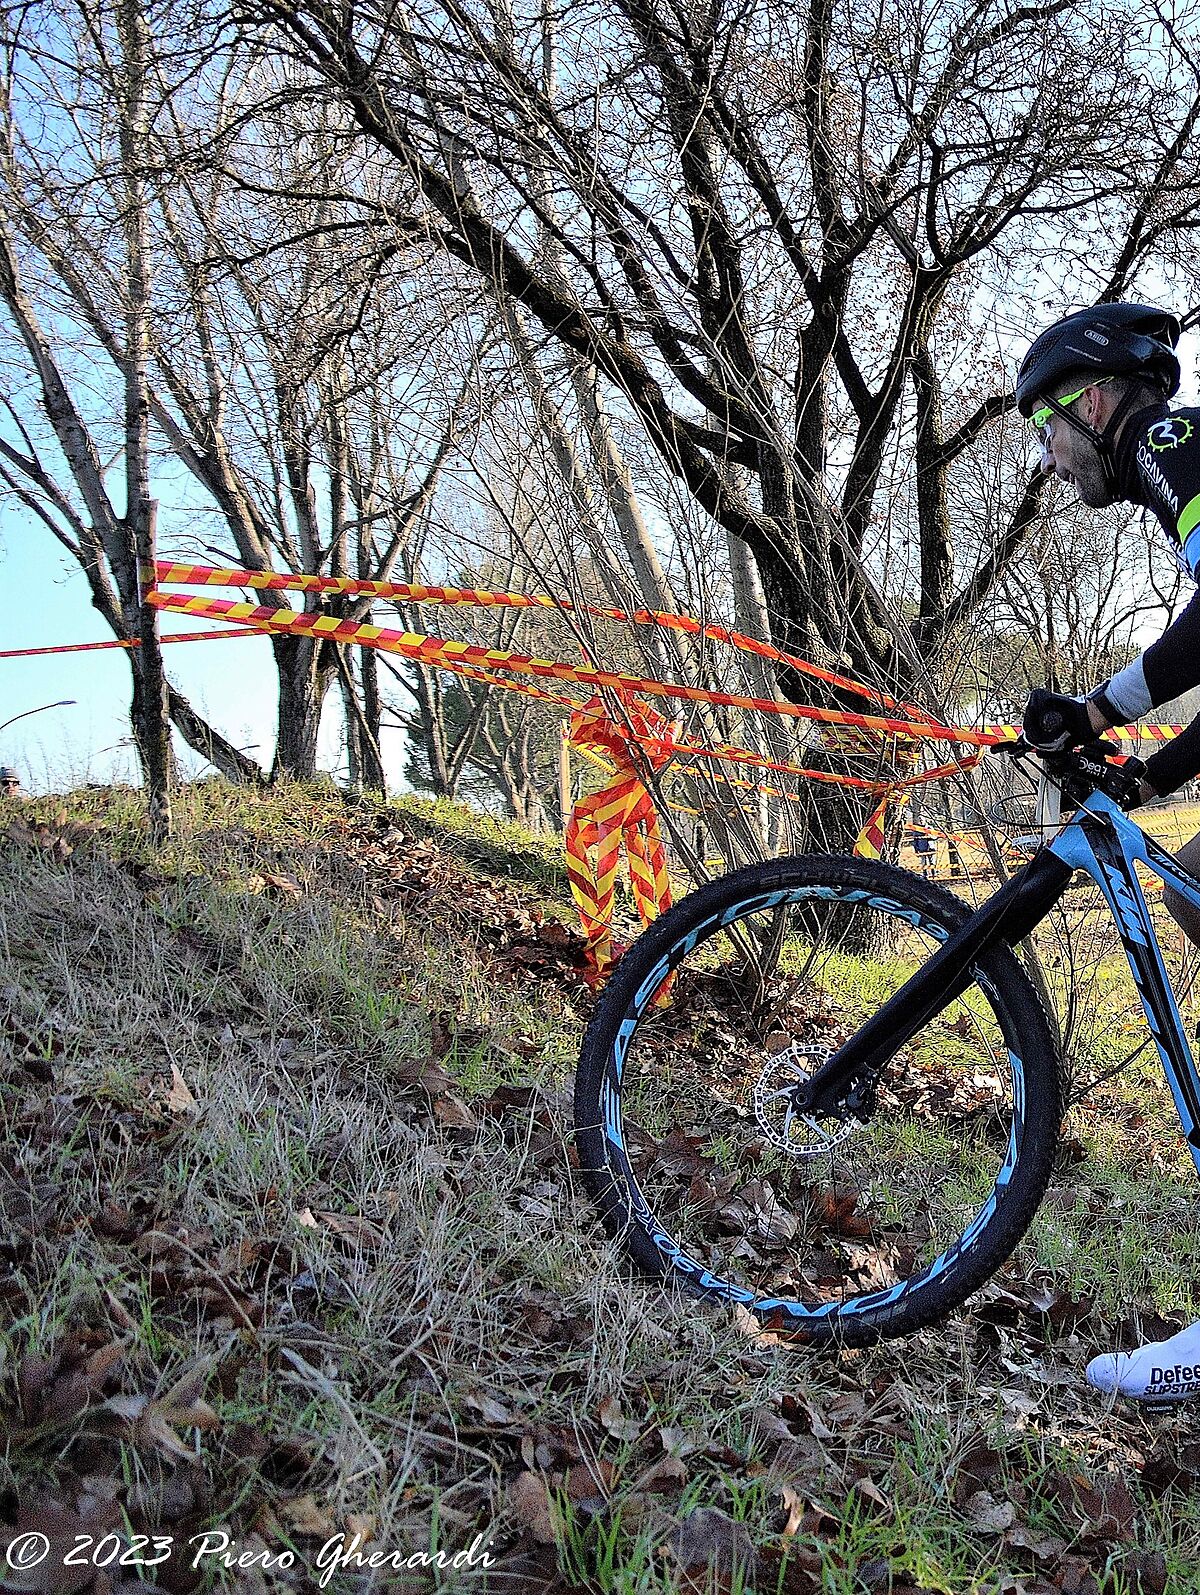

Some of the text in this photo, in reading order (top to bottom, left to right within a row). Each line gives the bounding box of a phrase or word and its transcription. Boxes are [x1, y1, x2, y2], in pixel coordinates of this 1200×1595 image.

[1137, 440, 1178, 512] OCAVINA
[1102, 861, 1149, 948] KTM
[752, 1046, 1025, 1317] EASTON
